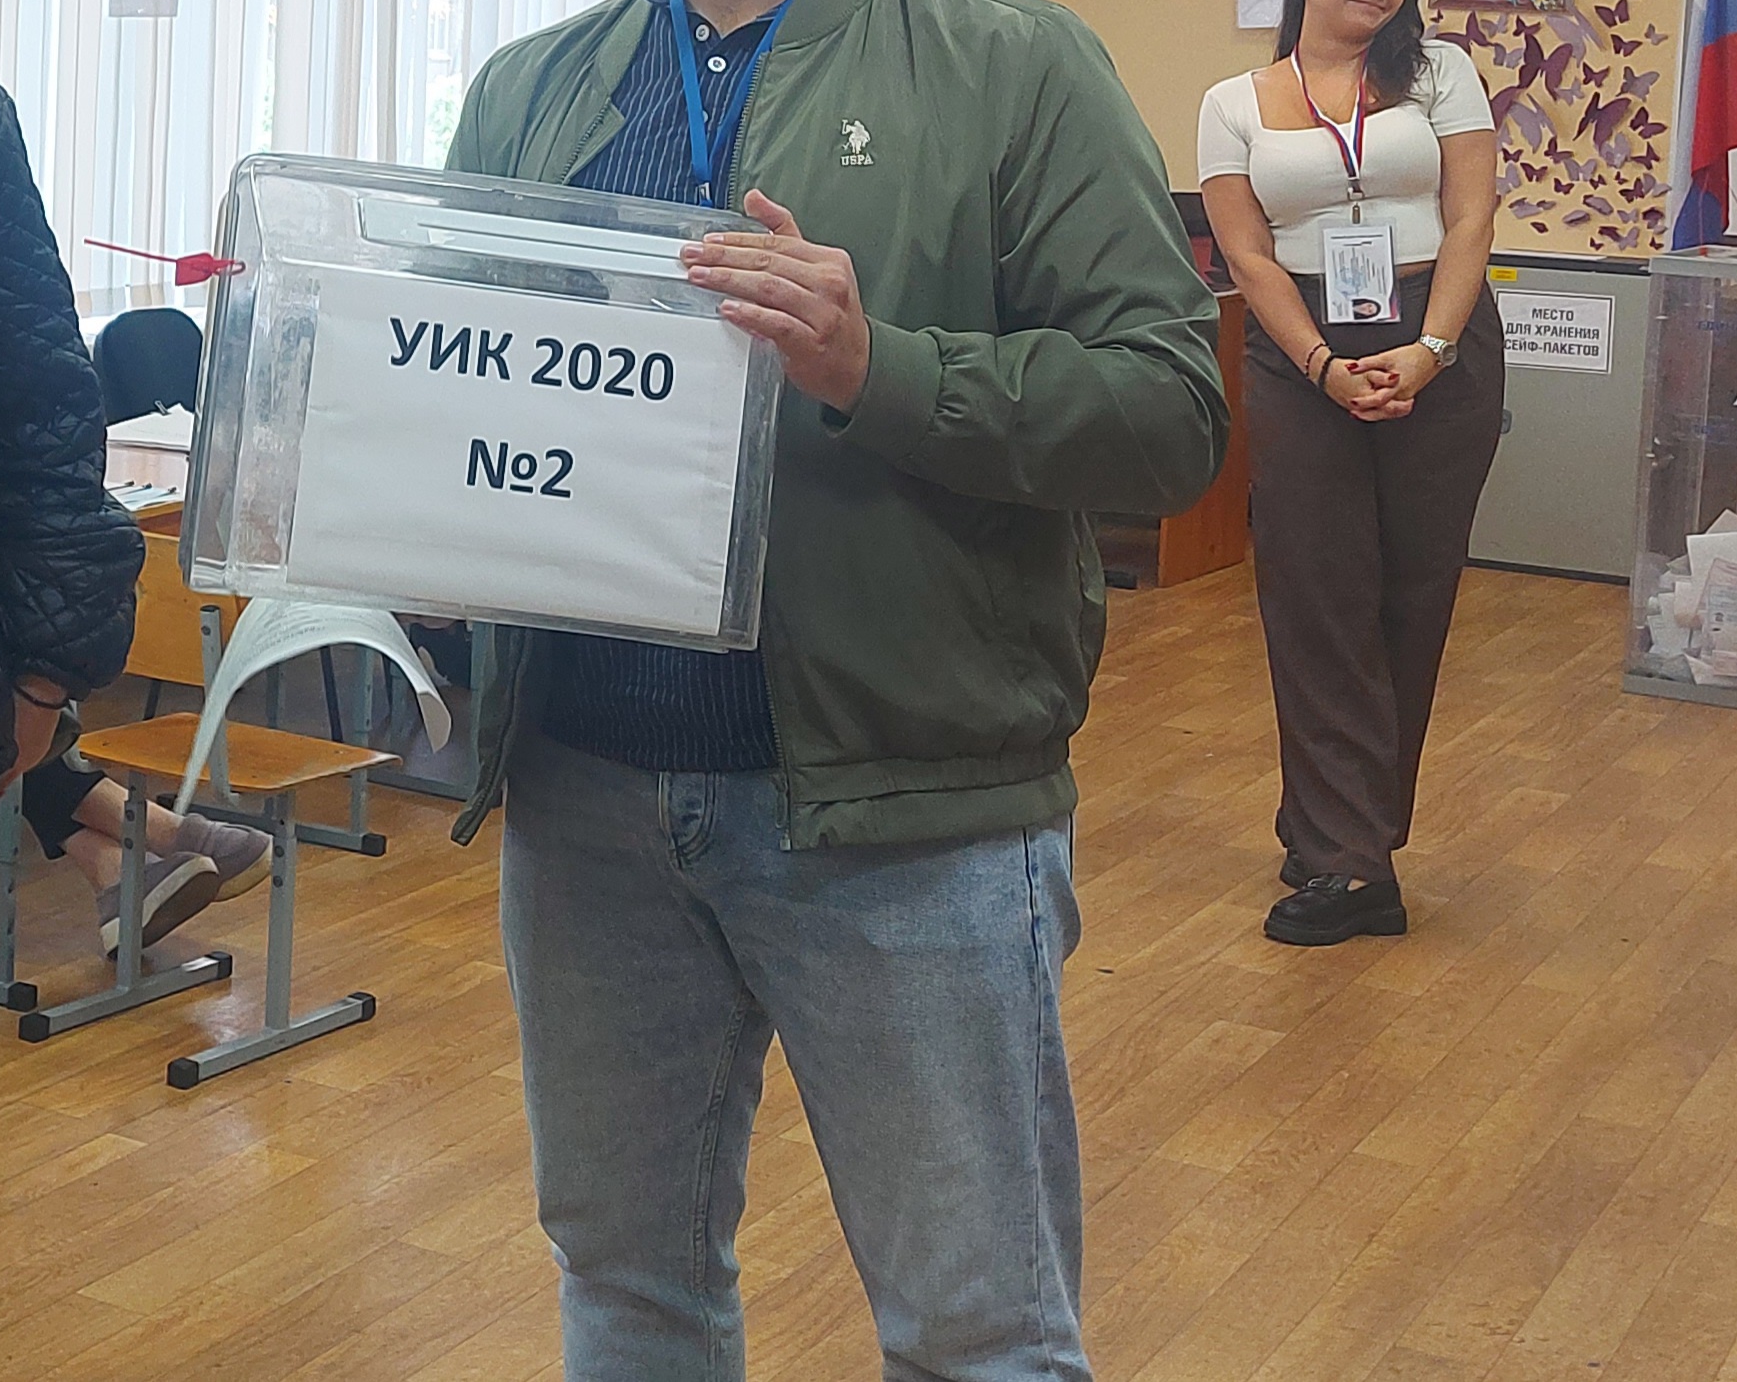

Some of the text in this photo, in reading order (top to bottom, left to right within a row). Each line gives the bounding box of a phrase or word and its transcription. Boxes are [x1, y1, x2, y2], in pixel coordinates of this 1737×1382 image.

[840, 152, 874, 166] USPA
[1531, 308, 1574, 322] МЕСТО
[1505, 322, 1600, 340] ДЛЯ ХРАНЕНИЯ
[1504, 338, 1600, 357] СЕЙФ-ПАКЕТОВ
[388, 316, 675, 401] УИК 2020
[467, 439, 575, 499] №2
